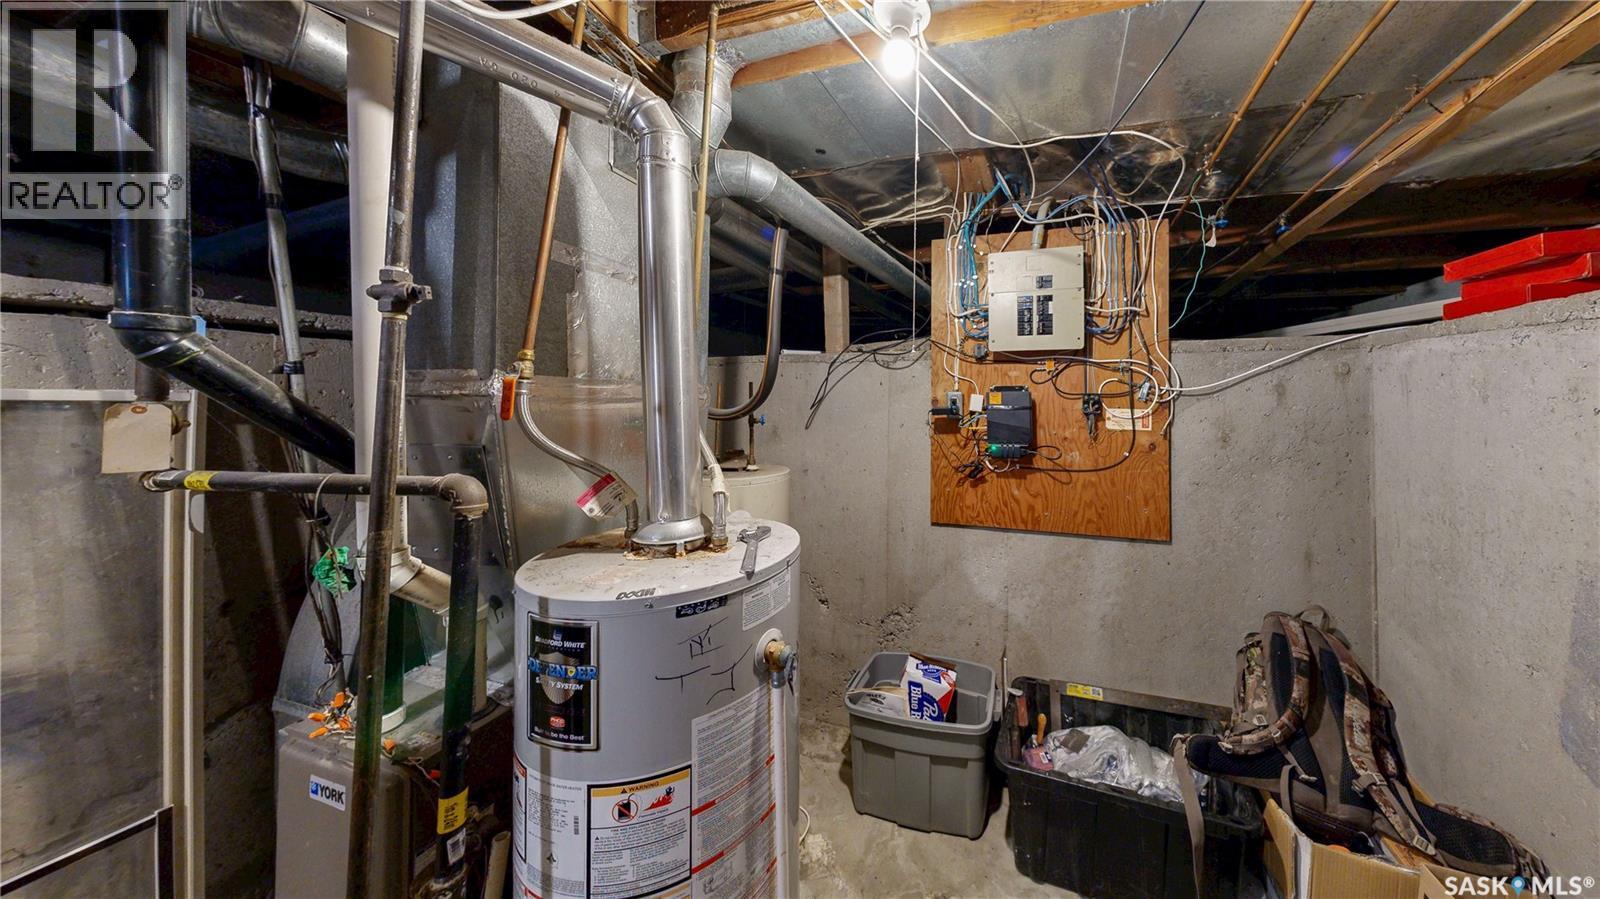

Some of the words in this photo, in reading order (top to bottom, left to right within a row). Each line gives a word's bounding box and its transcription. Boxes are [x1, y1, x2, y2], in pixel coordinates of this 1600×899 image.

[563, 641, 586, 649] WHITE
[556, 681, 584, 690] SYSTEM
[911, 685, 922, 709] Blue
[628, 780, 660, 793] WARNING
[319, 784, 344, 804] YORK
